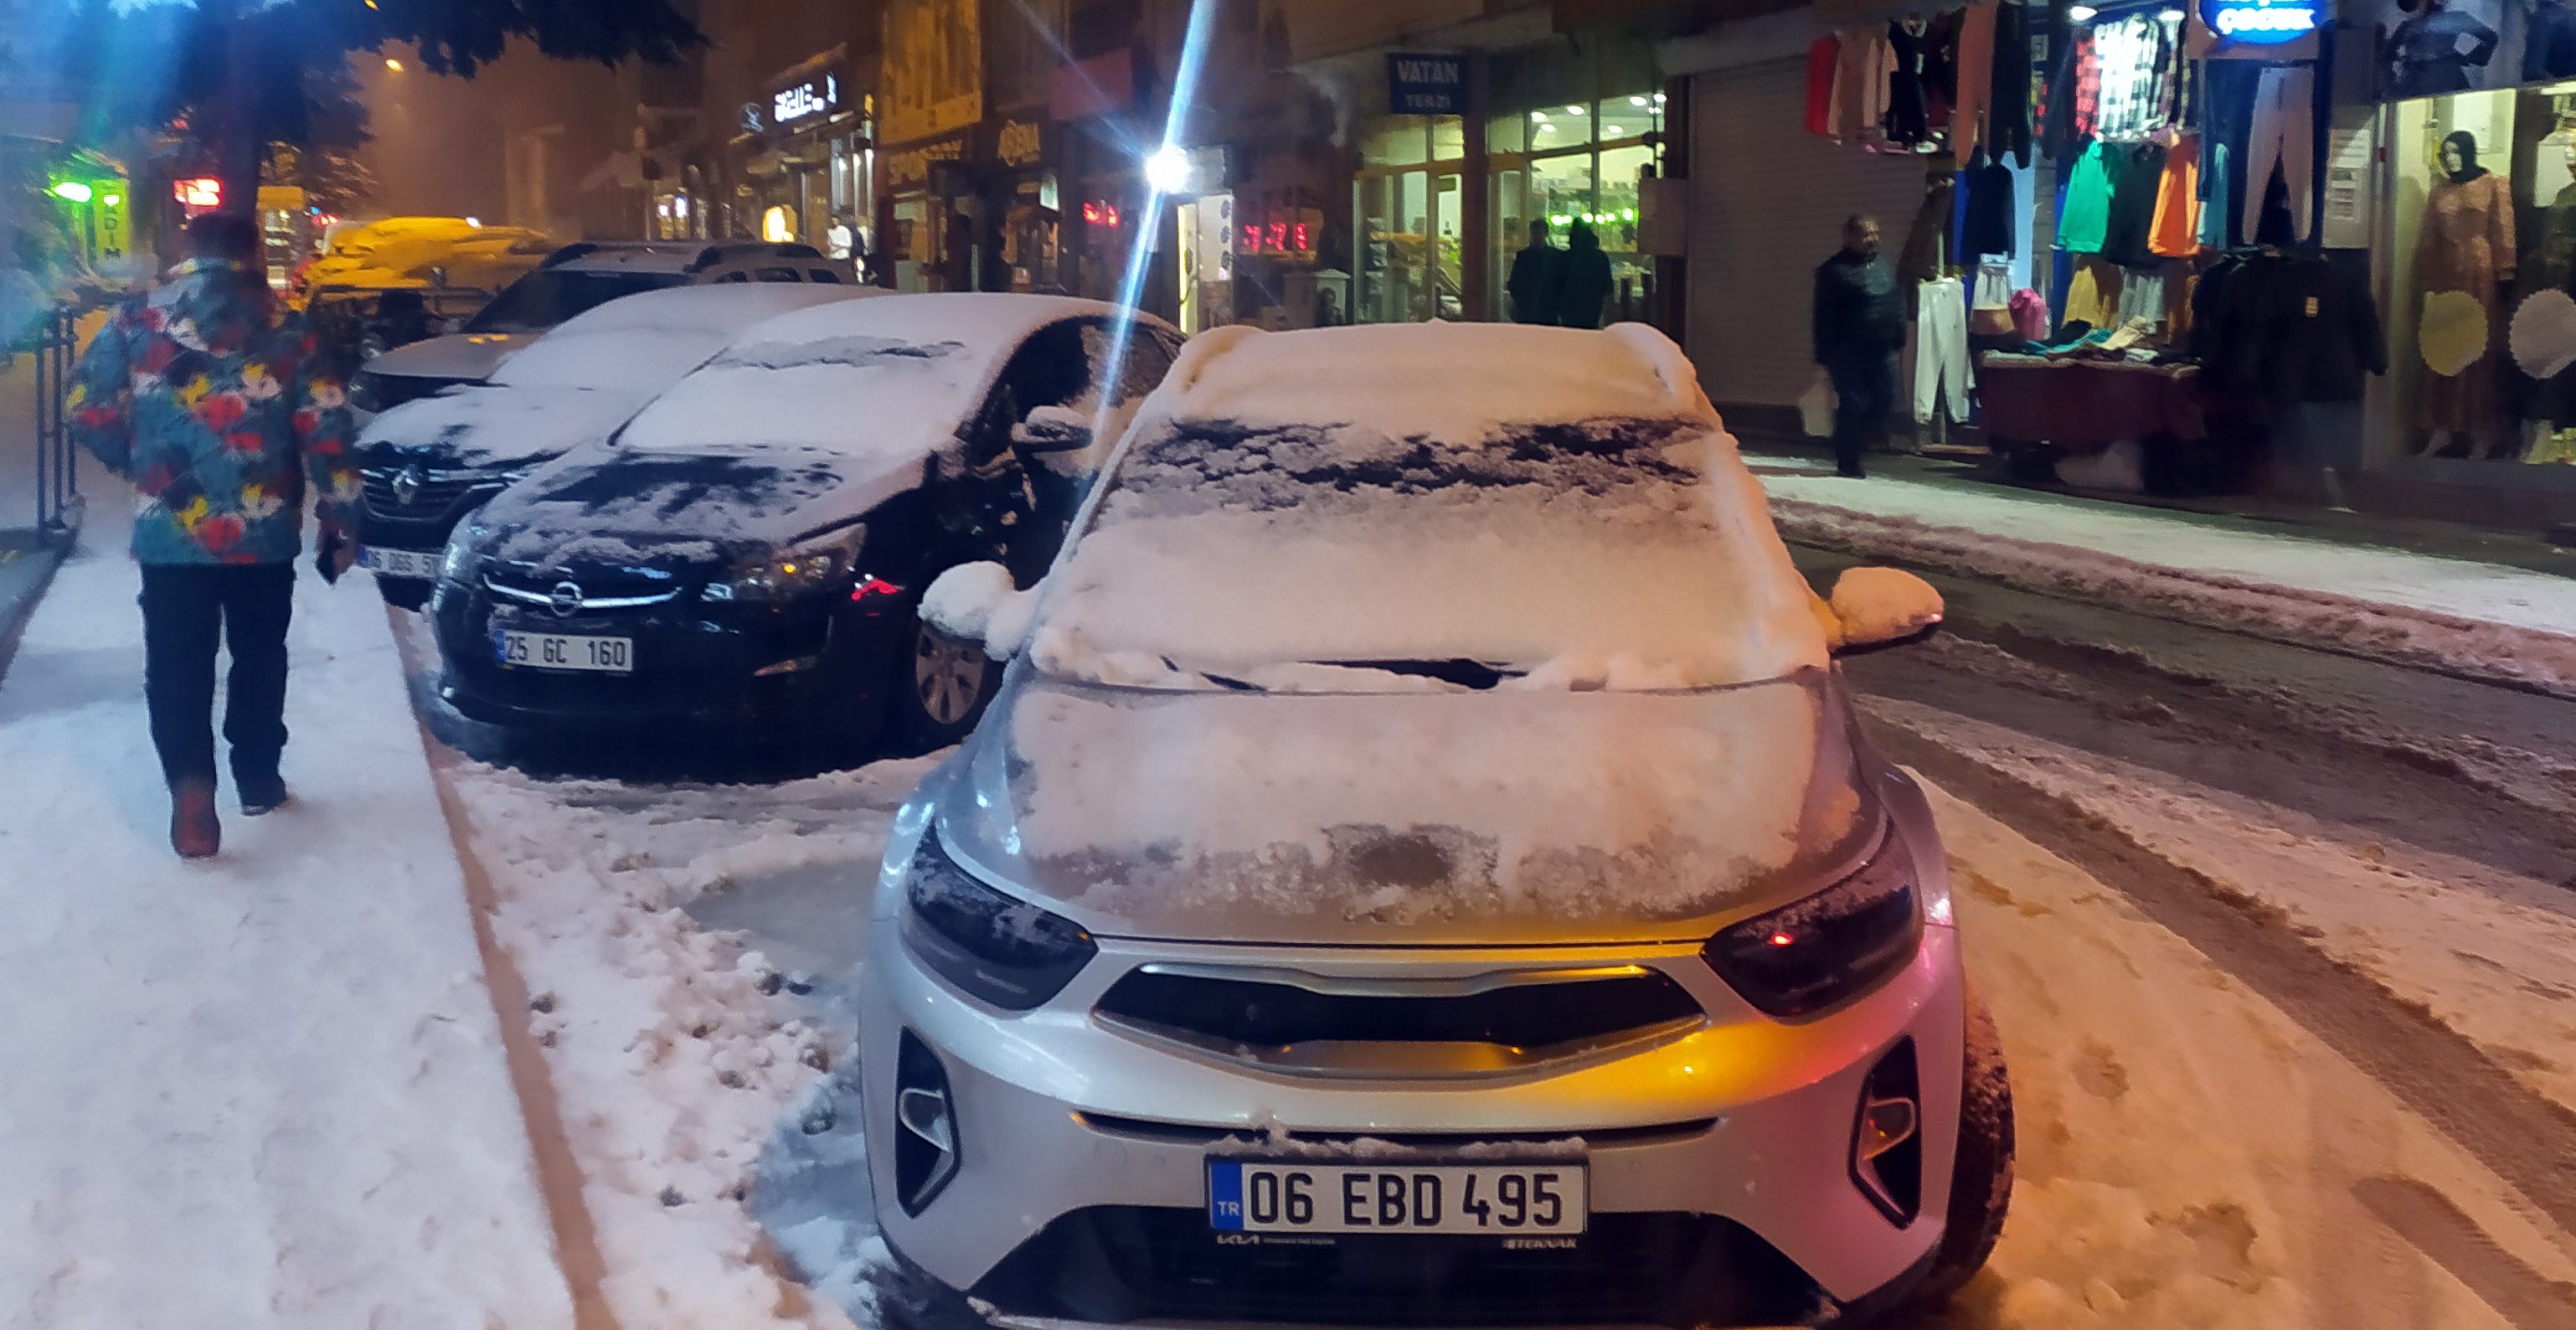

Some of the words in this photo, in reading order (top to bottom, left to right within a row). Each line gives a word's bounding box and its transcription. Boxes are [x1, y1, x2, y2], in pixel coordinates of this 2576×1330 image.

[1397, 59, 1459, 83] VATAN
[505, 635, 528, 662] 25
[542, 637, 568, 664] GC
[587, 640, 626, 667] 160
[1217, 1200, 1240, 1217] TR
[1249, 1171, 1314, 1225] 06
[1342, 1173, 1442, 1227] EBD
[1461, 1173, 1564, 1228] 495
